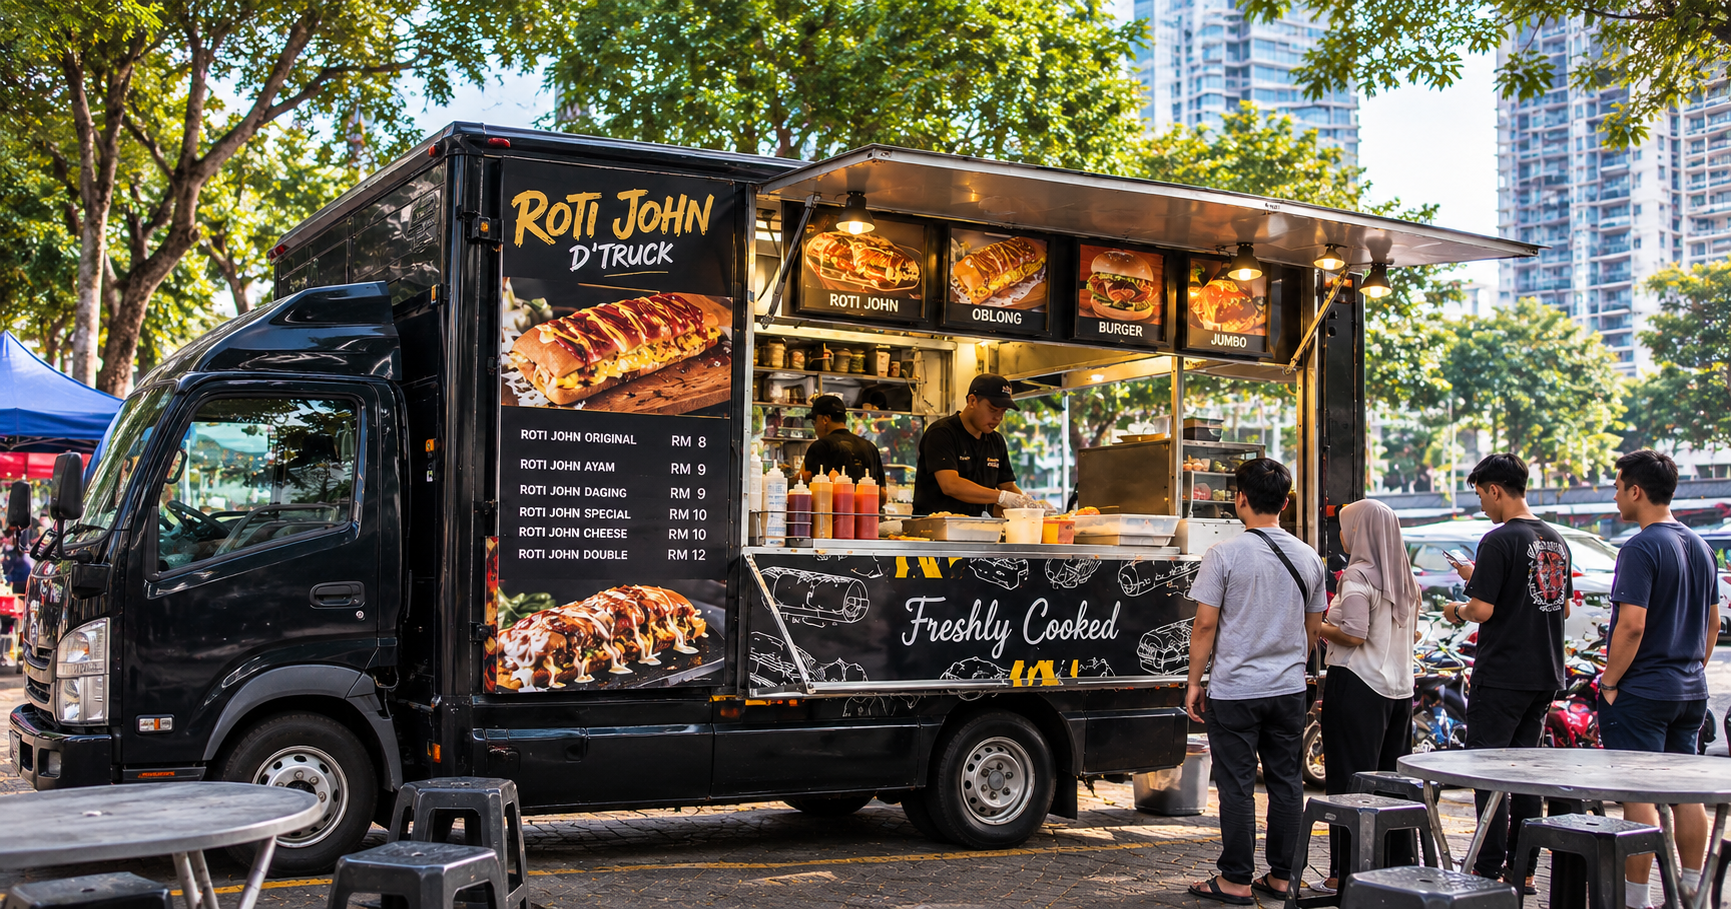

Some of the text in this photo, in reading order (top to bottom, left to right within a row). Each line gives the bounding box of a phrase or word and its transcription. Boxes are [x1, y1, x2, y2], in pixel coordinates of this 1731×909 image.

[511, 189, 715, 248] ROTI JOHN
[569, 241, 674, 272] D'TRUCK
[829, 293, 899, 313] ROTI JOHN
[972, 308, 1023, 325] OBLONG
[1099, 321, 1143, 338] BURGER
[1210, 333, 1248, 349] JUMBO
[521, 429, 707, 448] ROTI JOHN ORIGINAL RM 8
[520, 458, 706, 476] ROTI JOHN AYAM RM 9
[520, 484, 706, 500] ROTI JOHN DAGING RM 9
[519, 506, 707, 521] ROTI JOHN SPECIAL RM 10
[519, 526, 707, 541] ROTI JOHN CHEESE RM 10
[518, 548, 706, 561] ROTI JOHN DOUBLE RM 12
[901, 596, 1120, 659] Freshly Cooked
